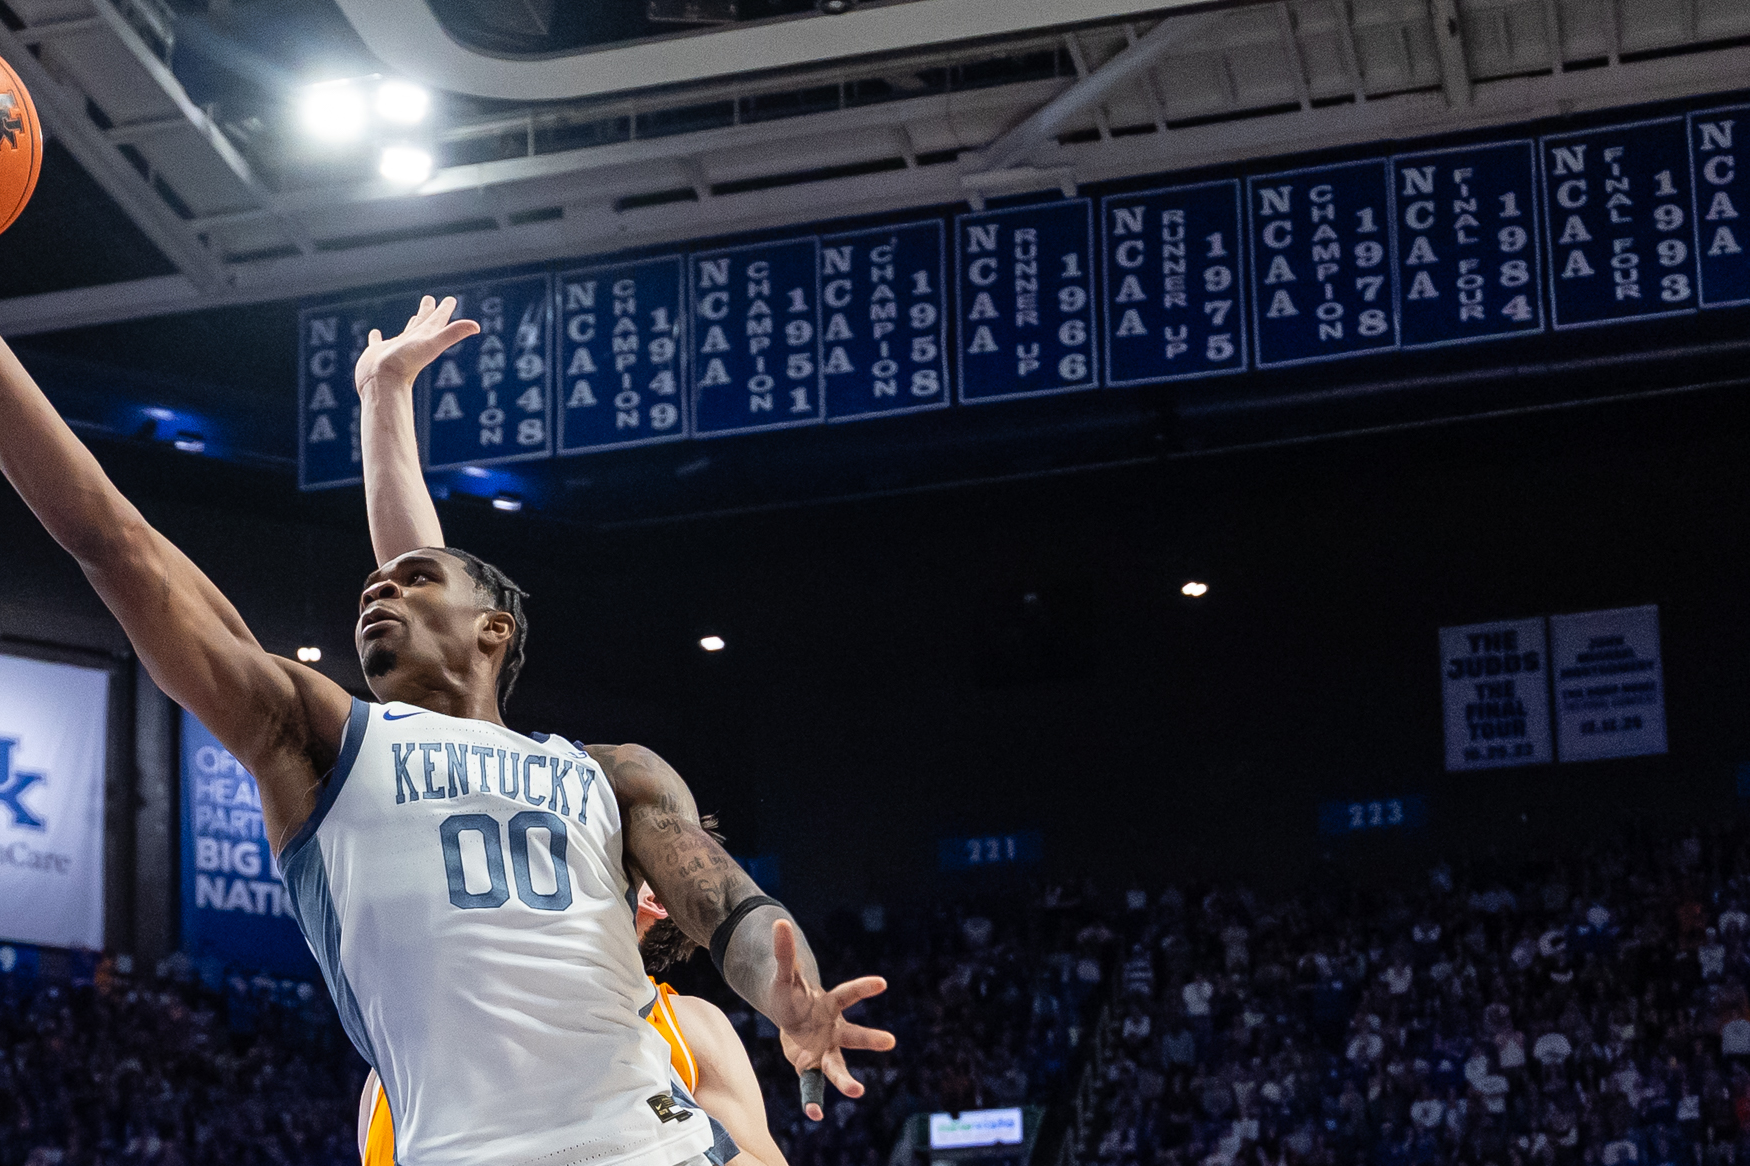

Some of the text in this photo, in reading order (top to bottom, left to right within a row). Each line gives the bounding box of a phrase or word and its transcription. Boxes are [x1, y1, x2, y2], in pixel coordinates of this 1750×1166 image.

[1402, 166, 1439, 300] NCAA
[1453, 167, 1480, 244] FINAL
[1552, 145, 1595, 278] NCAA
[1603, 146, 1632, 224] FINAL
[1653, 170, 1691, 301] 1993
[1699, 120, 1741, 257] NCAA
[823, 246, 854, 374] NCAA
[967, 225, 999, 353] NCAA
[1014, 228, 1039, 327] RUNNER
[1113, 206, 1147, 337] NCAA
[1162, 210, 1187, 309] RUNNER
[1204, 232, 1234, 361] 1975
[1259, 186, 1299, 318] NCAA
[1309, 185, 1344, 341] CHAMPION
[1354, 207, 1388, 336] 1978
[1457, 258, 1485, 322] FOUR
[1498, 191, 1532, 321] 1984
[1610, 237, 1641, 300] FOUR
[308, 318, 338, 442] NCAA
[479, 298, 505, 446] CHAMPION
[566, 281, 597, 408] NCAA
[613, 280, 640, 430] CHAMPION
[649, 307, 678, 430] 1949
[698, 259, 731, 387] NCAA
[746, 262, 774, 412] CHAMPION
[785, 288, 814, 412] 1951
[870, 245, 898, 397] CHAMPION
[910, 270, 940, 397] 1958
[1016, 342, 1040, 377] UP
[1058, 253, 1087, 380] 1966
[1164, 325, 1188, 359] UP
[1447, 651, 1540, 680] JUDDS
[1467, 631, 1518, 654] THE
[1474, 680, 1516, 700] THE
[1465, 700, 1527, 721] FINAL
[1469, 718, 1527, 741] TOUR
[392, 742, 596, 825] KENTUCKY
[196, 836, 262, 877] BIG
[439, 810, 573, 912] 00
